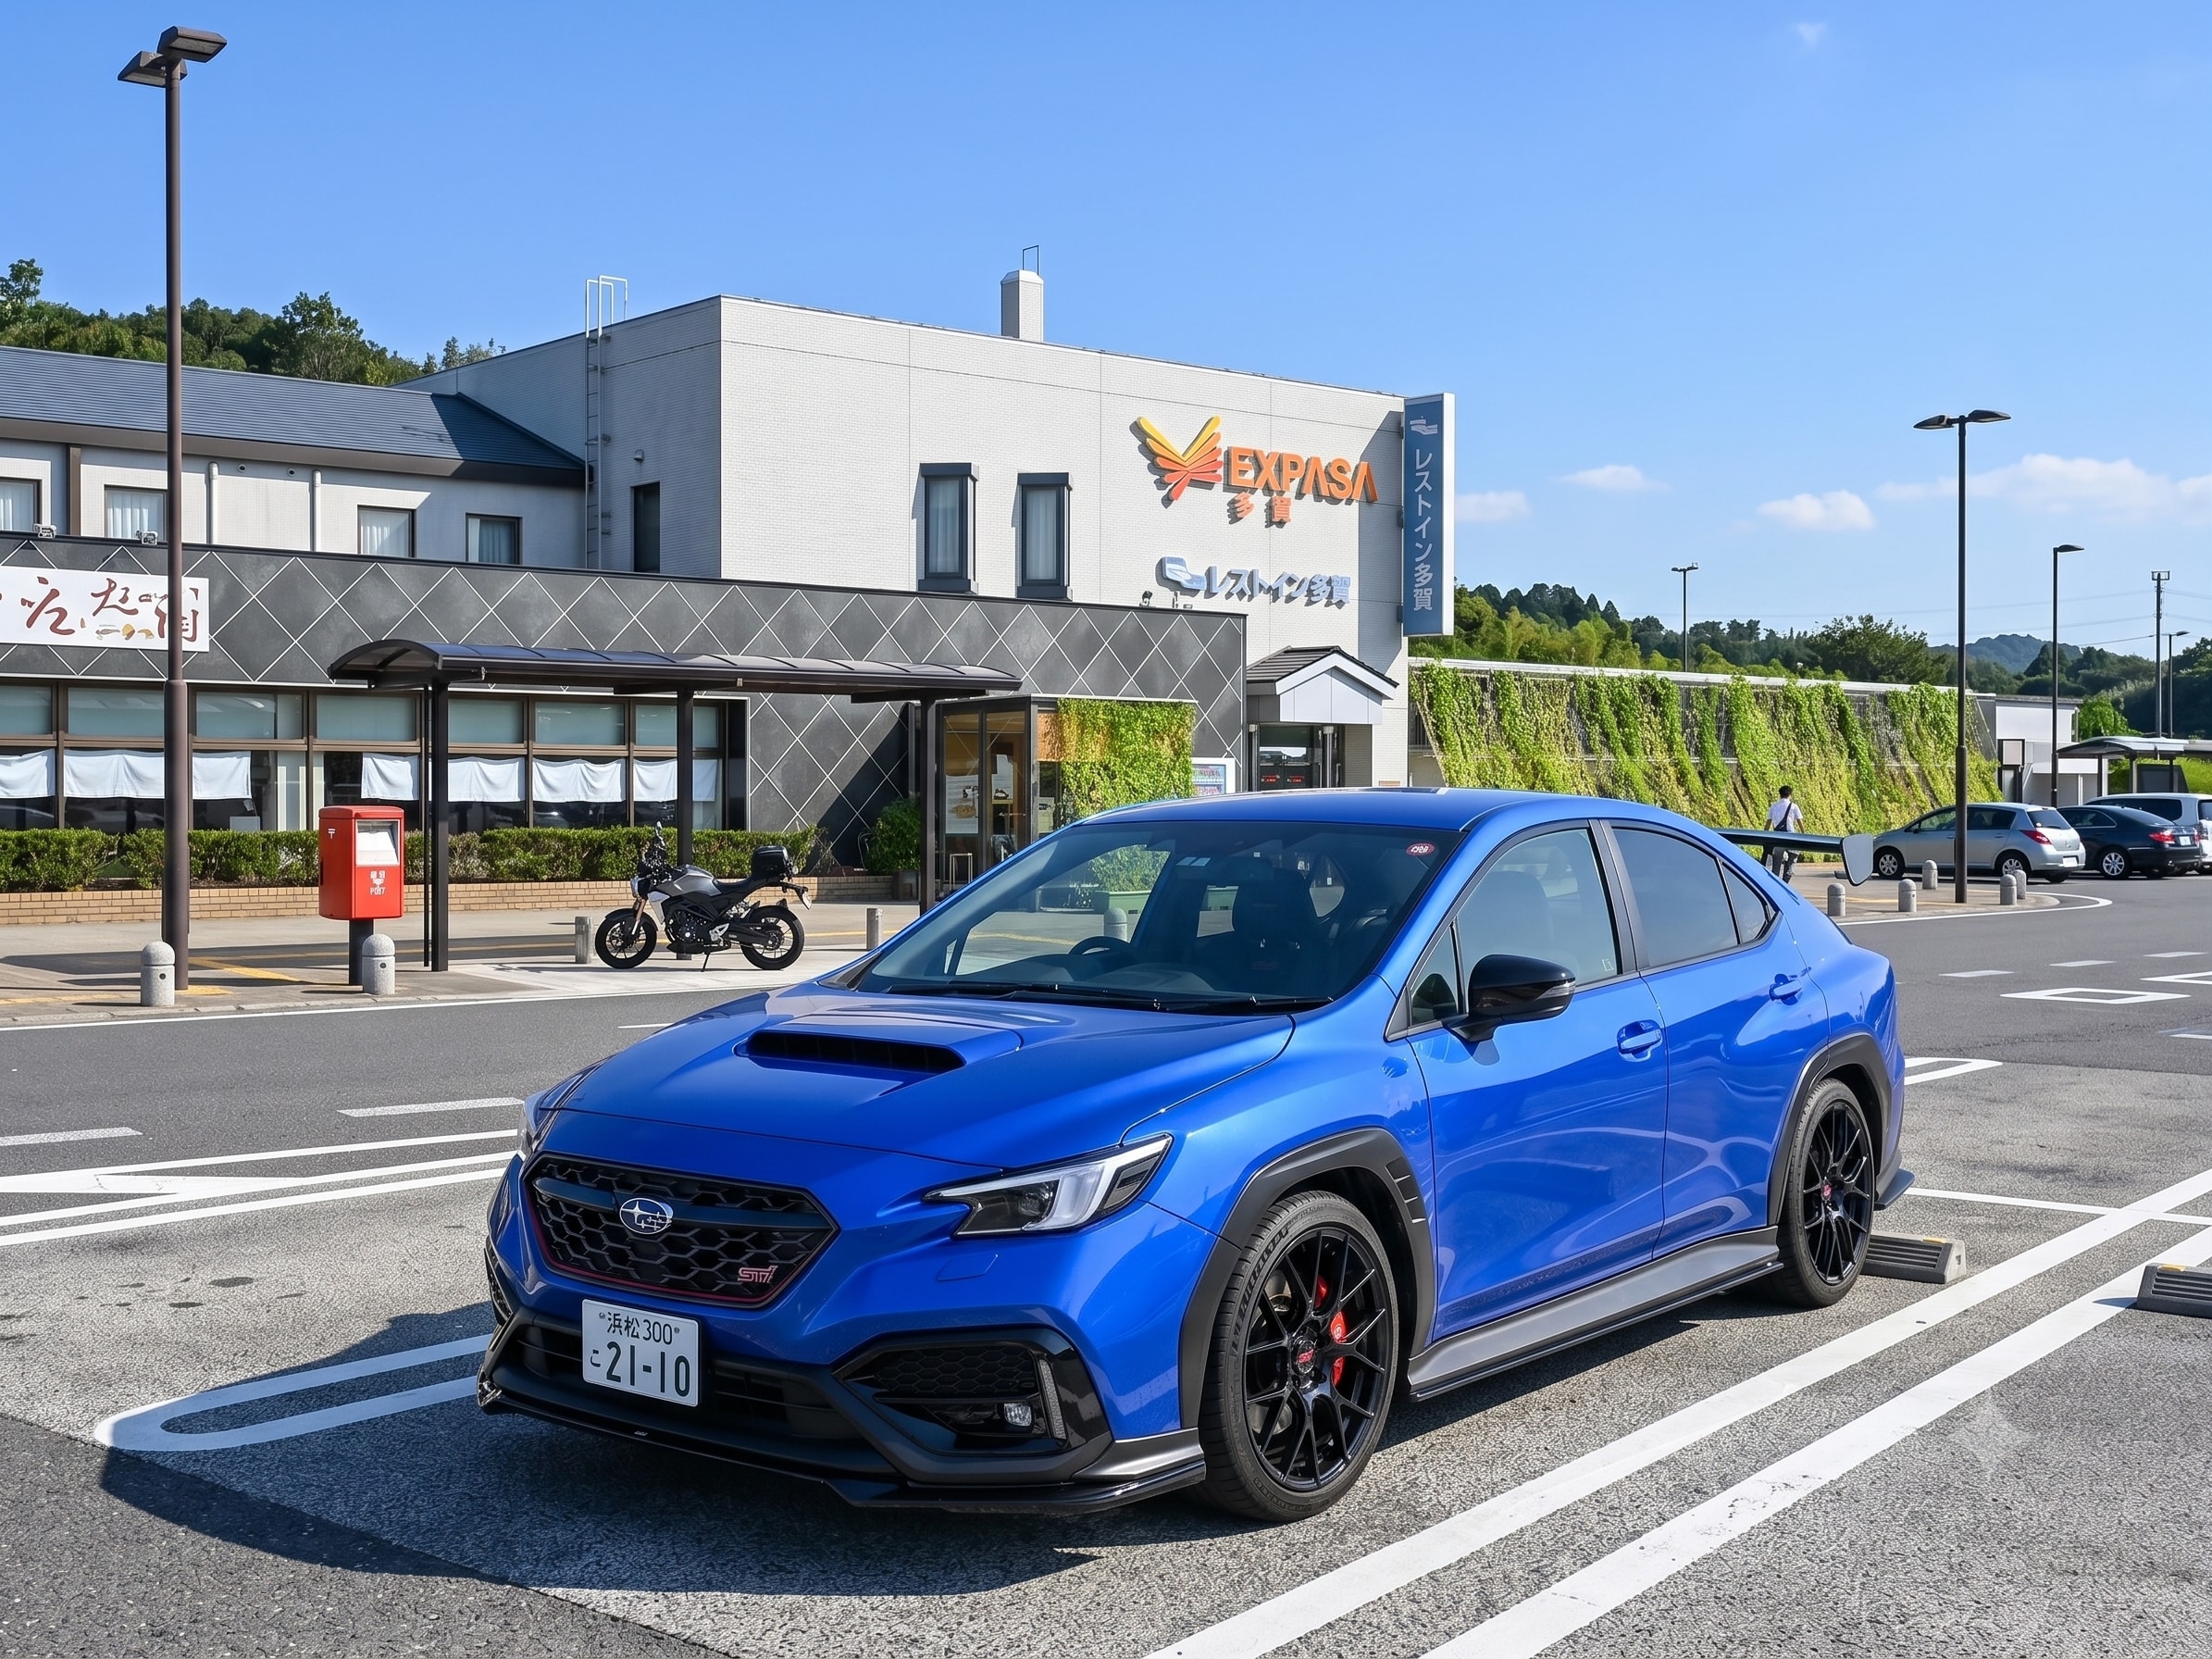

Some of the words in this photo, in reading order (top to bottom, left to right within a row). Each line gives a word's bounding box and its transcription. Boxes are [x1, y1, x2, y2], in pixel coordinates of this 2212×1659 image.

[1228, 446, 1378, 503] EXPASA
[1412, 448, 1434, 612] レストイン多賀
[606, 1341, 690, 1397] 21-10
